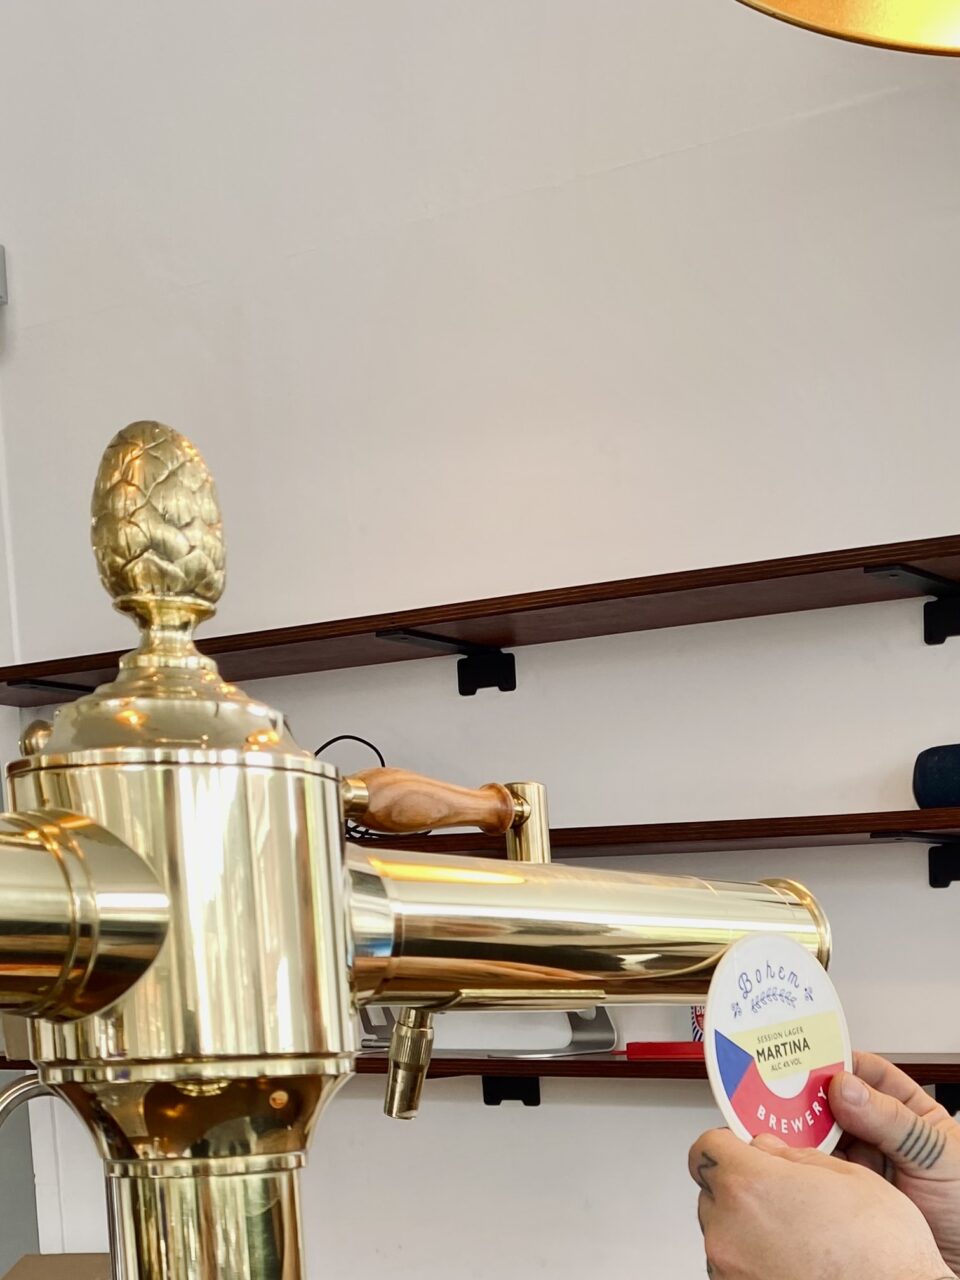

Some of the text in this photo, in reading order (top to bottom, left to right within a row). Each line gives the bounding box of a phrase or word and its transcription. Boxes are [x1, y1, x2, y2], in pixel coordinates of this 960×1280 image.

[738, 960, 800, 1000] Bohem
[756, 1037, 811, 1064] MARTINA
[757, 1025, 805, 1044] SESSION LAGER
[756, 1086, 828, 1134] BREWERY
